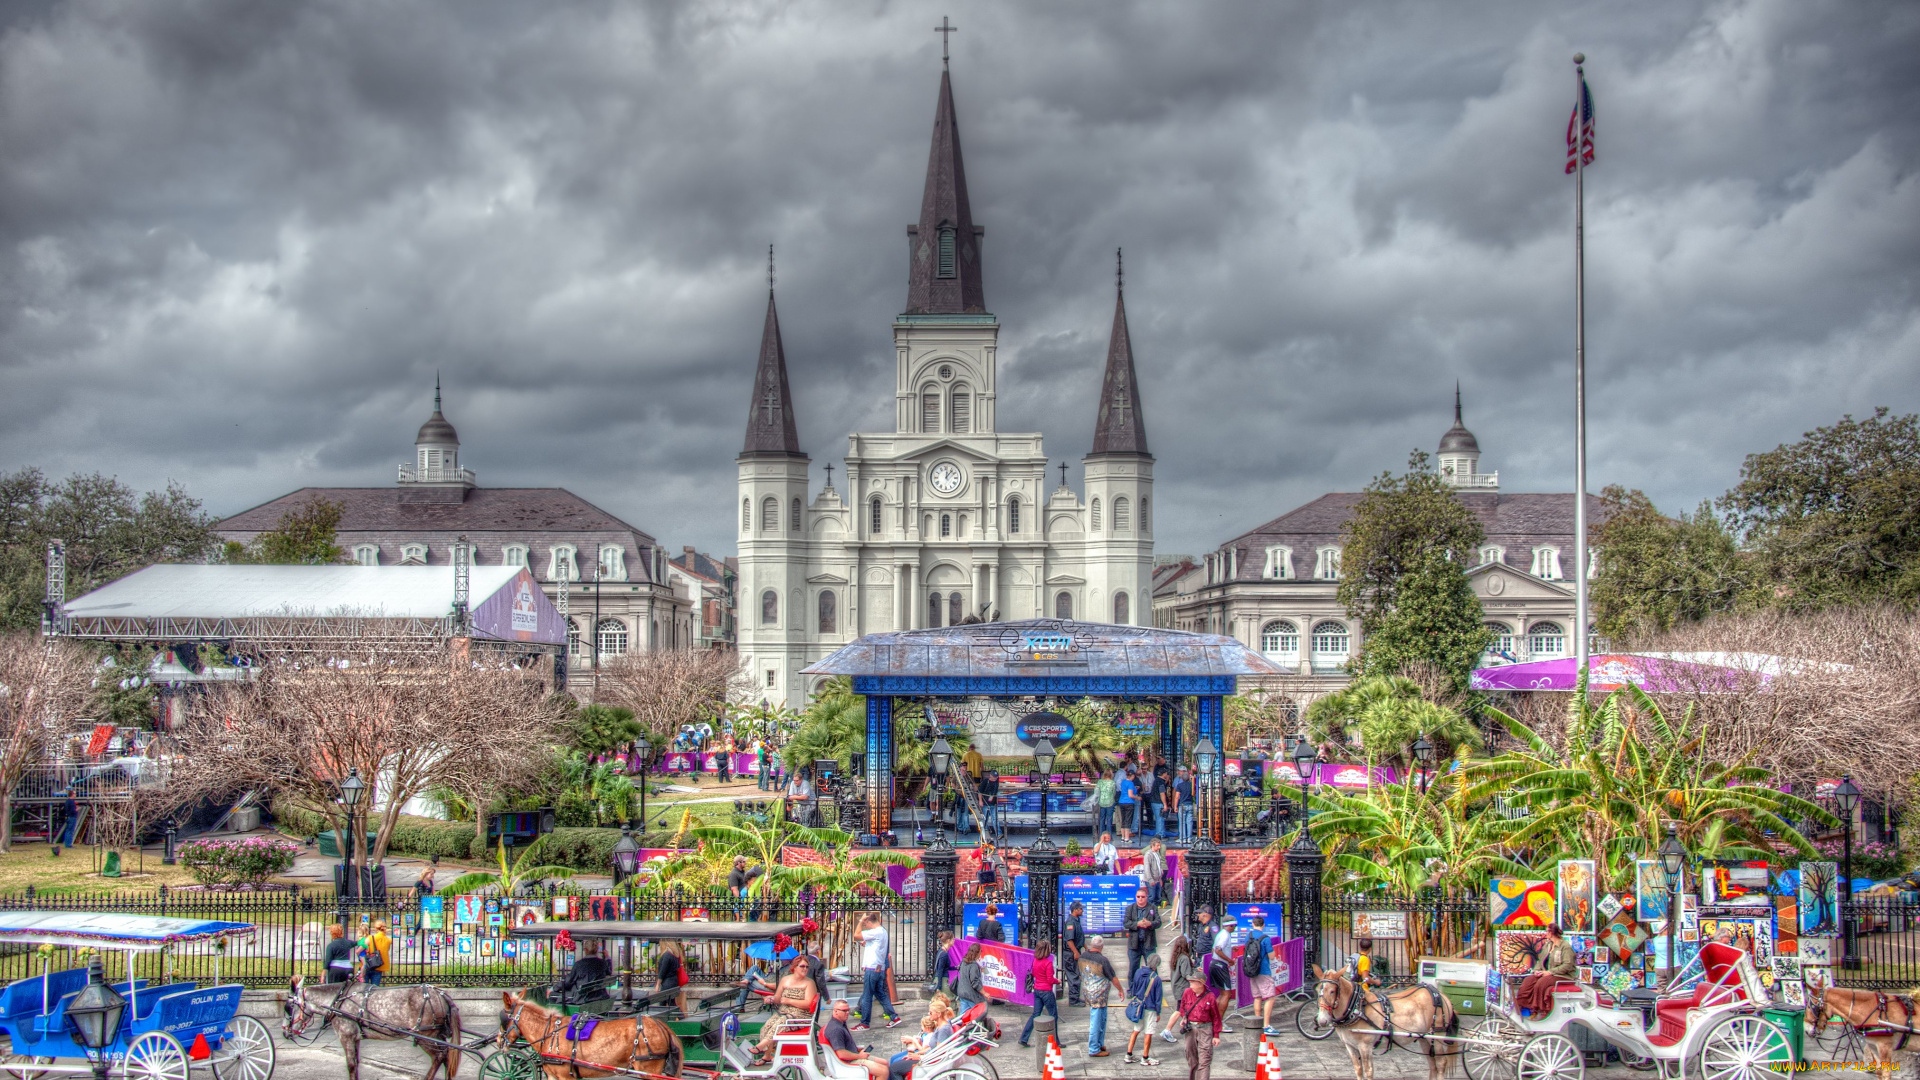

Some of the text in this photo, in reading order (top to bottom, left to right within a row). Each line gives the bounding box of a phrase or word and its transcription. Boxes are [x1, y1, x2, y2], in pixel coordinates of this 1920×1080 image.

[1023, 636, 1071, 650] XLVII
[1116, 717, 1157, 729] XLVII
[986, 961, 999, 971] CBS
[984, 975, 1015, 986] BOWL PARK
[191, 993, 229, 1005] ROLLIN 20'S
[87, 1050, 109, 1059] ROLIN
